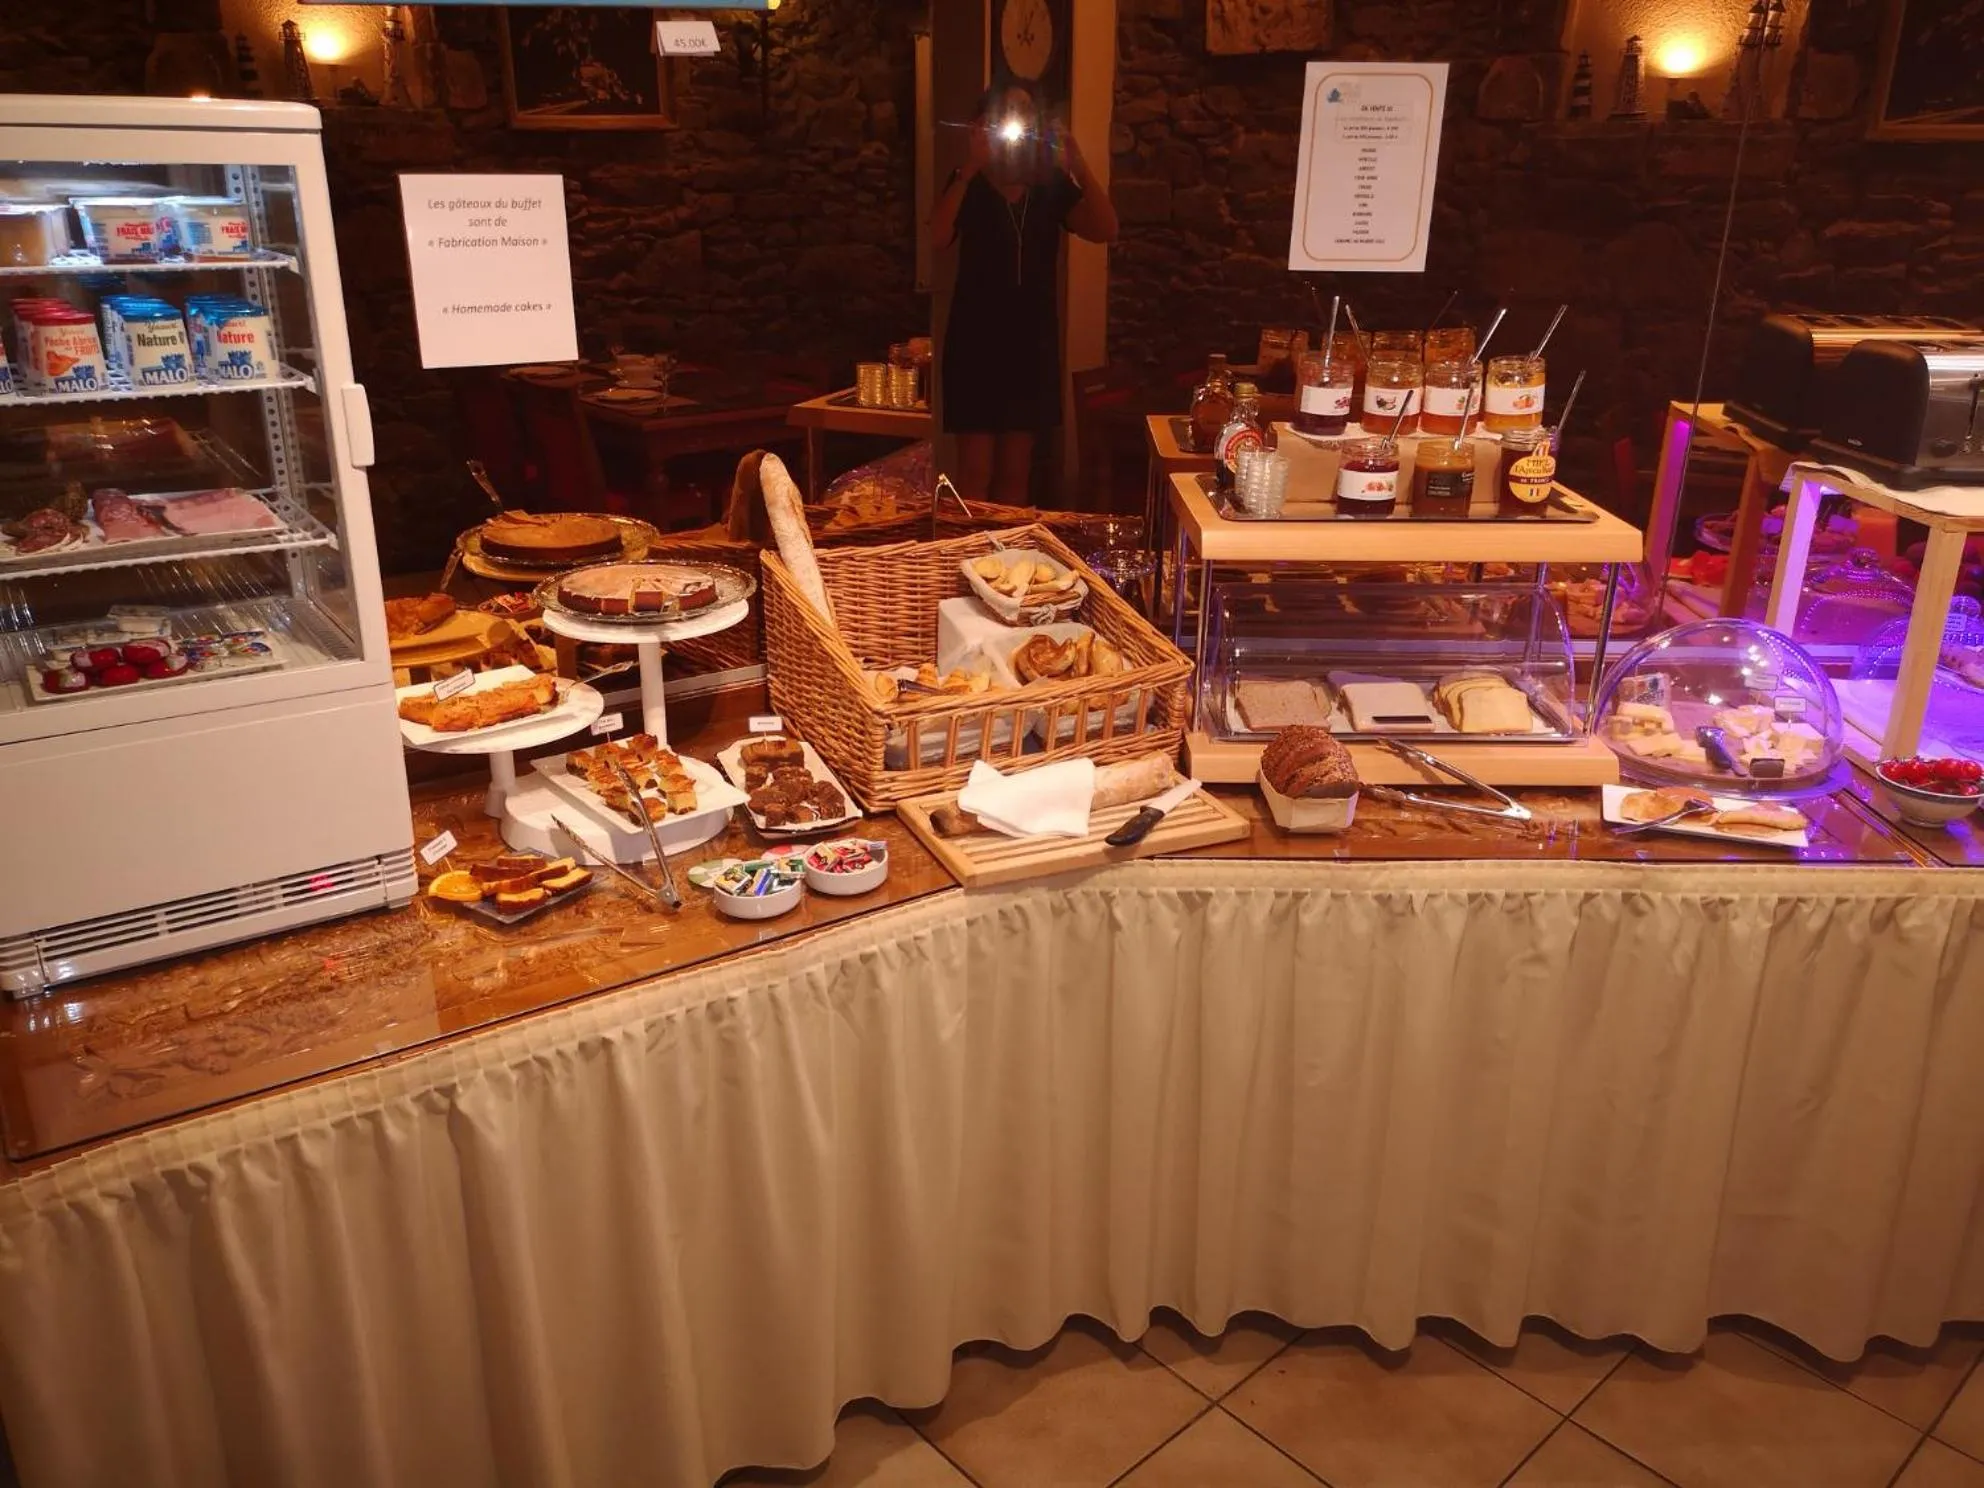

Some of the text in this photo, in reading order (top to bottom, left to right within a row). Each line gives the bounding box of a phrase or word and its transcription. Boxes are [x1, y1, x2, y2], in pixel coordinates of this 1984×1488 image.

[428, 199, 445, 210] Les
[495, 199, 508, 209] du
[511, 199, 542, 211] buffet
[468, 216, 508, 227] sont de
[438, 237, 498, 249] Fabrication
[500, 236, 539, 247] Maison
[451, 303, 512, 314] Homemade
[515, 302, 543, 313] cakes
[137, 331, 178, 347] Nature
[217, 330, 255, 344] ature
[145, 367, 188, 385] MALO
[55, 378, 97, 393] MALO
